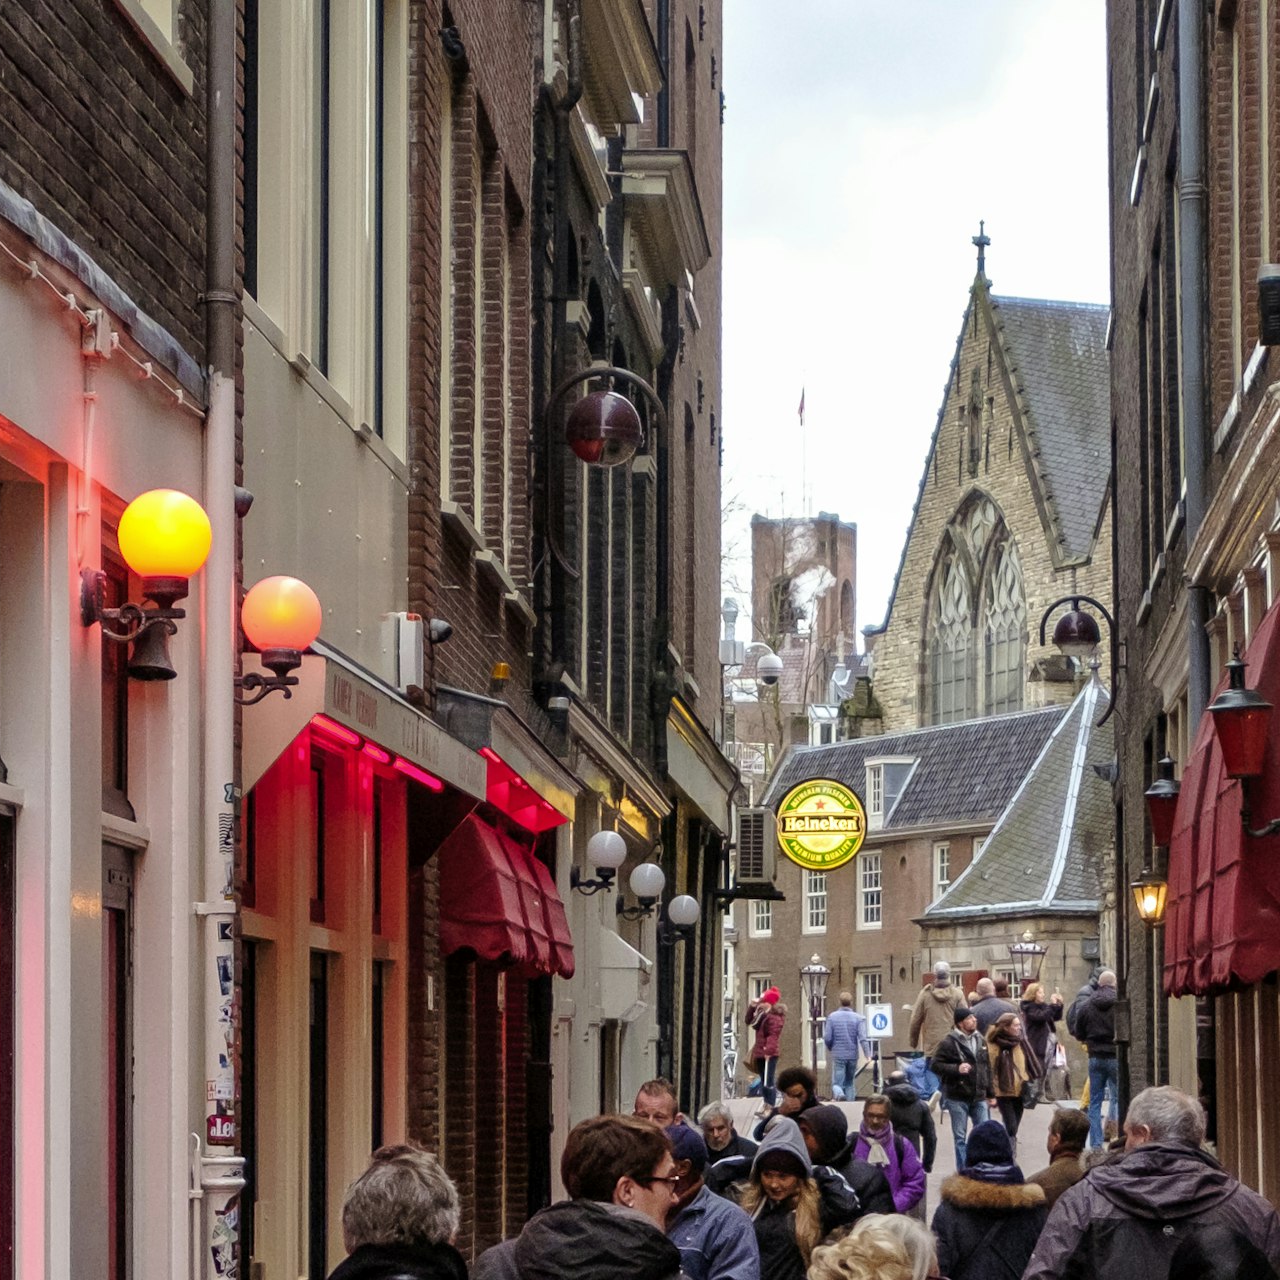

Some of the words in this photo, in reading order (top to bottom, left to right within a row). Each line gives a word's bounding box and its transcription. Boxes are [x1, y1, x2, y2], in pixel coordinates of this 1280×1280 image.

[784, 816, 858, 832] Heineken
[790, 841, 822, 862] PREMIUM
[824, 840, 853, 861] QUALITY
